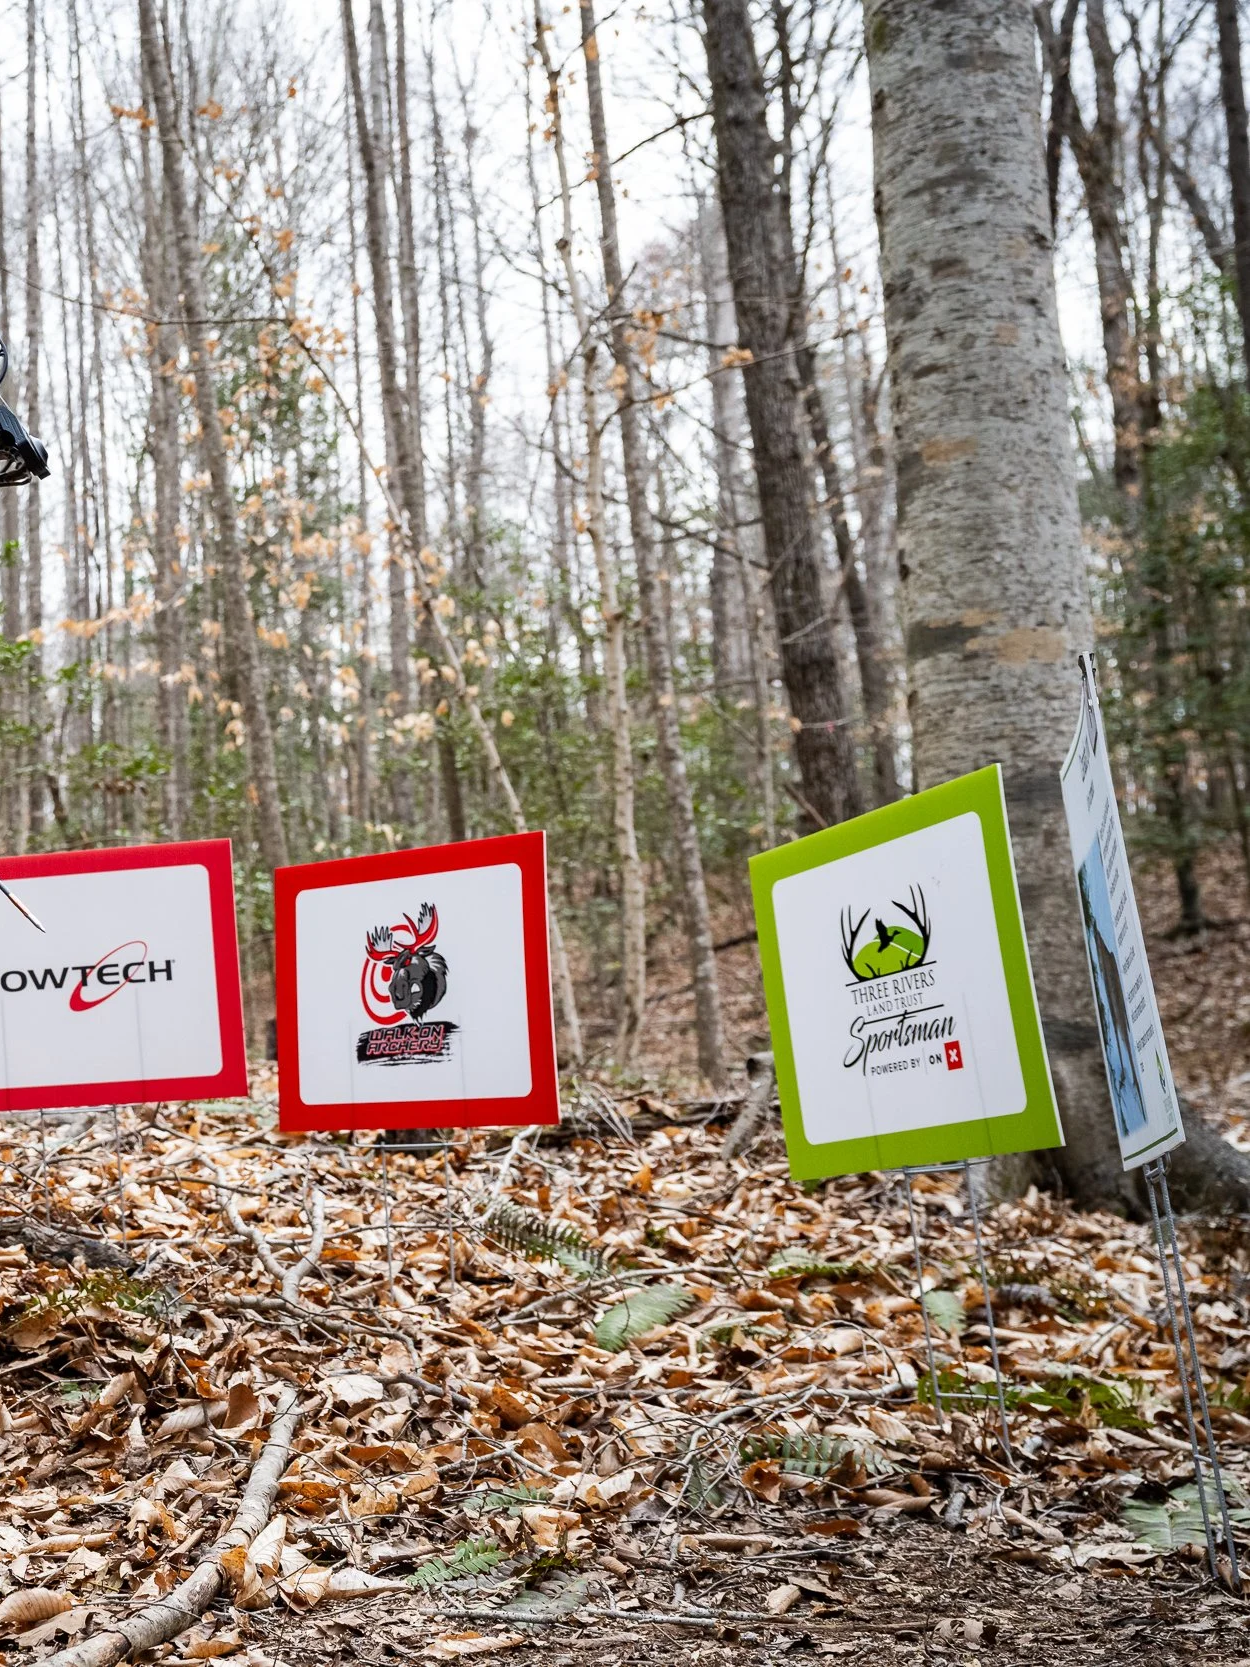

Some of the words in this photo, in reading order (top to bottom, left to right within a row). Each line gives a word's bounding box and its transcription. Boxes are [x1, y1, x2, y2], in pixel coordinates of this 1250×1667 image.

[851, 981, 890, 1005] THREE
[892, 969, 936, 996] RIVERS
[866, 1000, 892, 1017] LAND
[894, 992, 924, 1010] TRUST
[366, 1038, 444, 1056] ARCHERY
[843, 1010, 957, 1077] Sportsman
[871, 1060, 909, 1076] POWERED
[911, 1057, 922, 1069] BY
